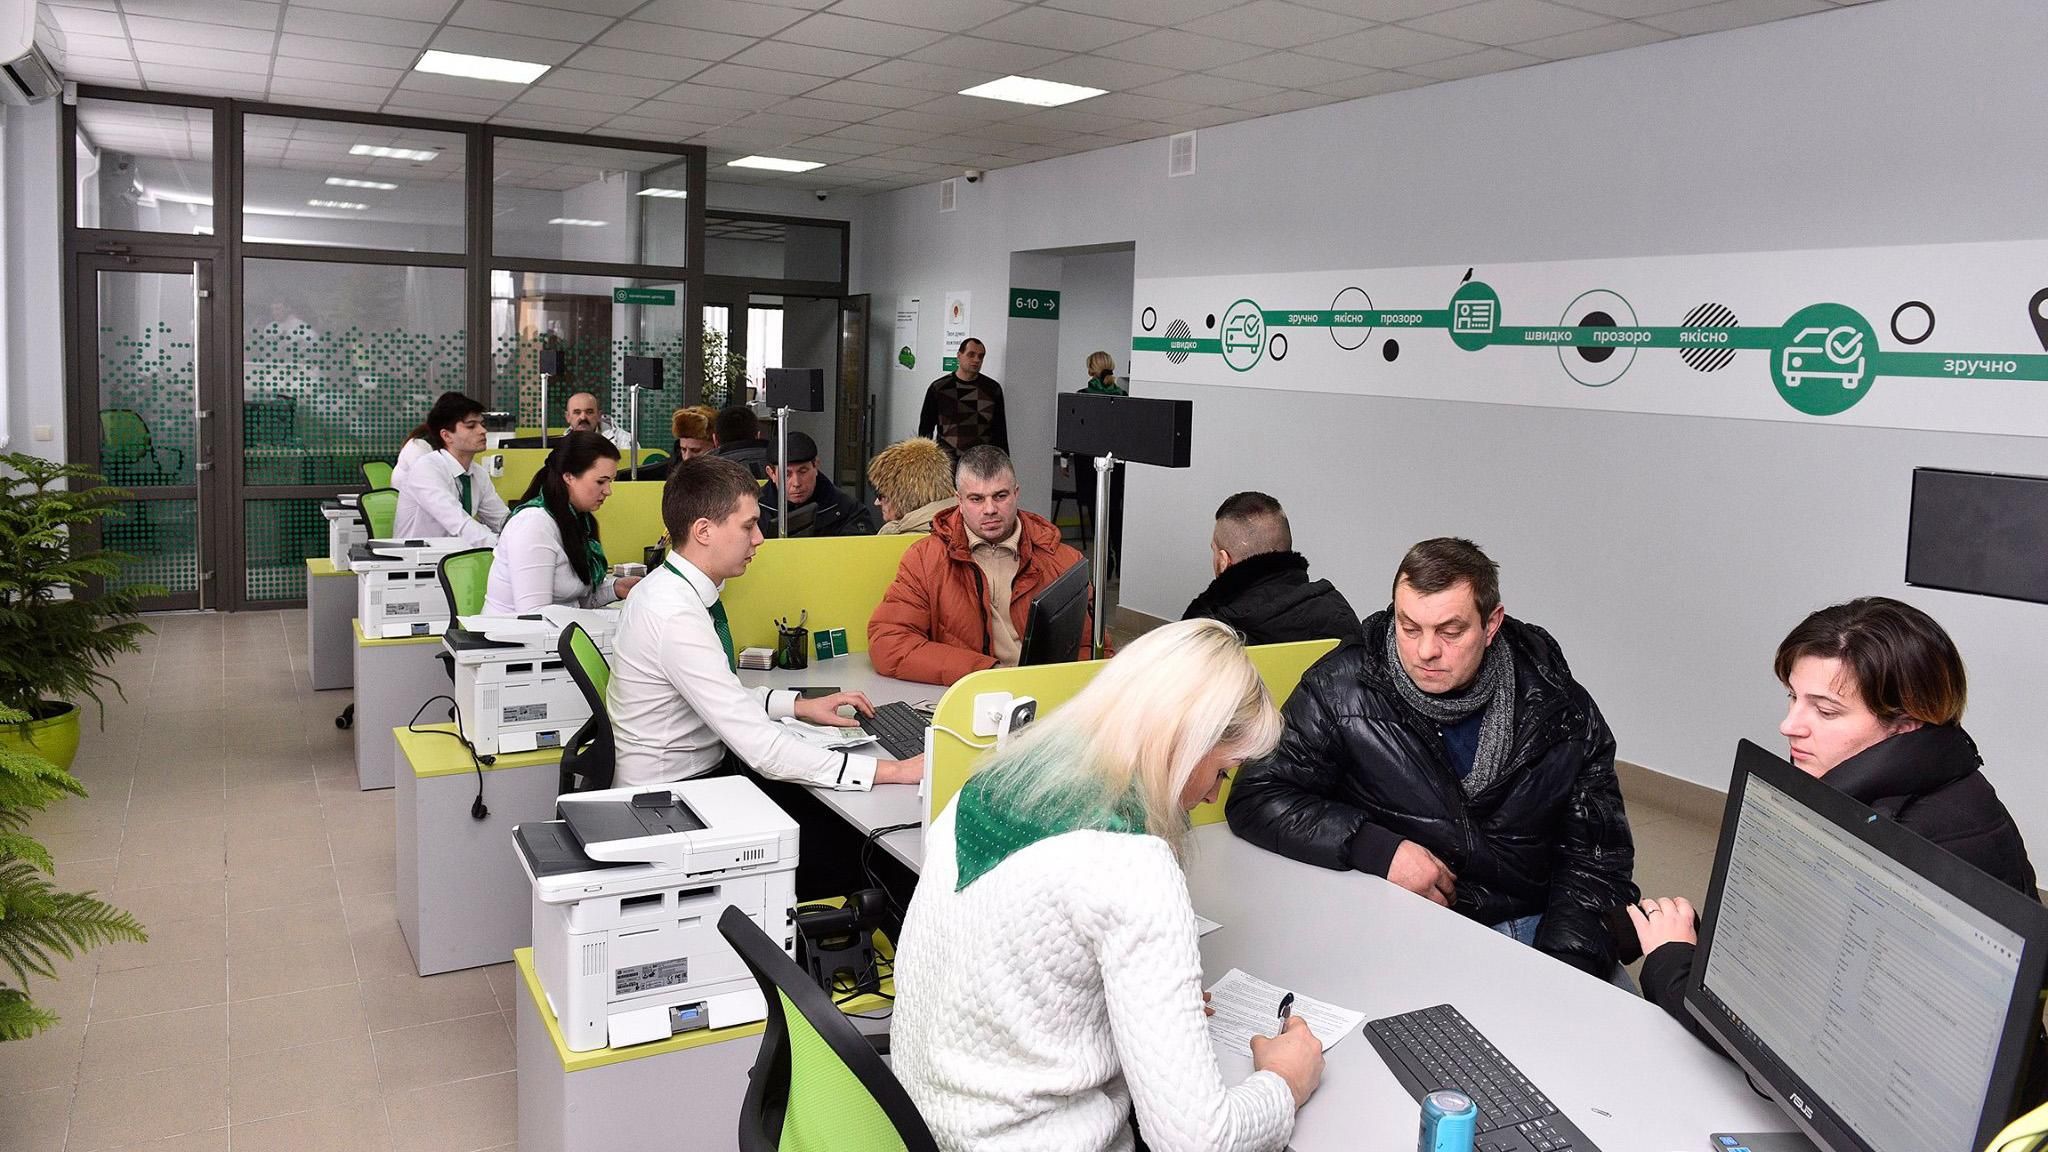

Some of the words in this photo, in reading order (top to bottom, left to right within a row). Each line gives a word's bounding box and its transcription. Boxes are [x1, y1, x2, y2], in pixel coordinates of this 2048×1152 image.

[1015, 297, 1039, 310] 6-10
[1287, 314, 1319, 325] зручно
[1334, 312, 1364, 324] якісно
[1380, 313, 1423, 326] прозоро
[1524, 330, 1573, 343] швидко
[1593, 330, 1652, 344] прозоро
[1679, 328, 1729, 344] якісно
[1170, 340, 1198, 350] швидко
[1943, 358, 2018, 376] зручно
[1789, 1092, 1814, 1120] ASUS
